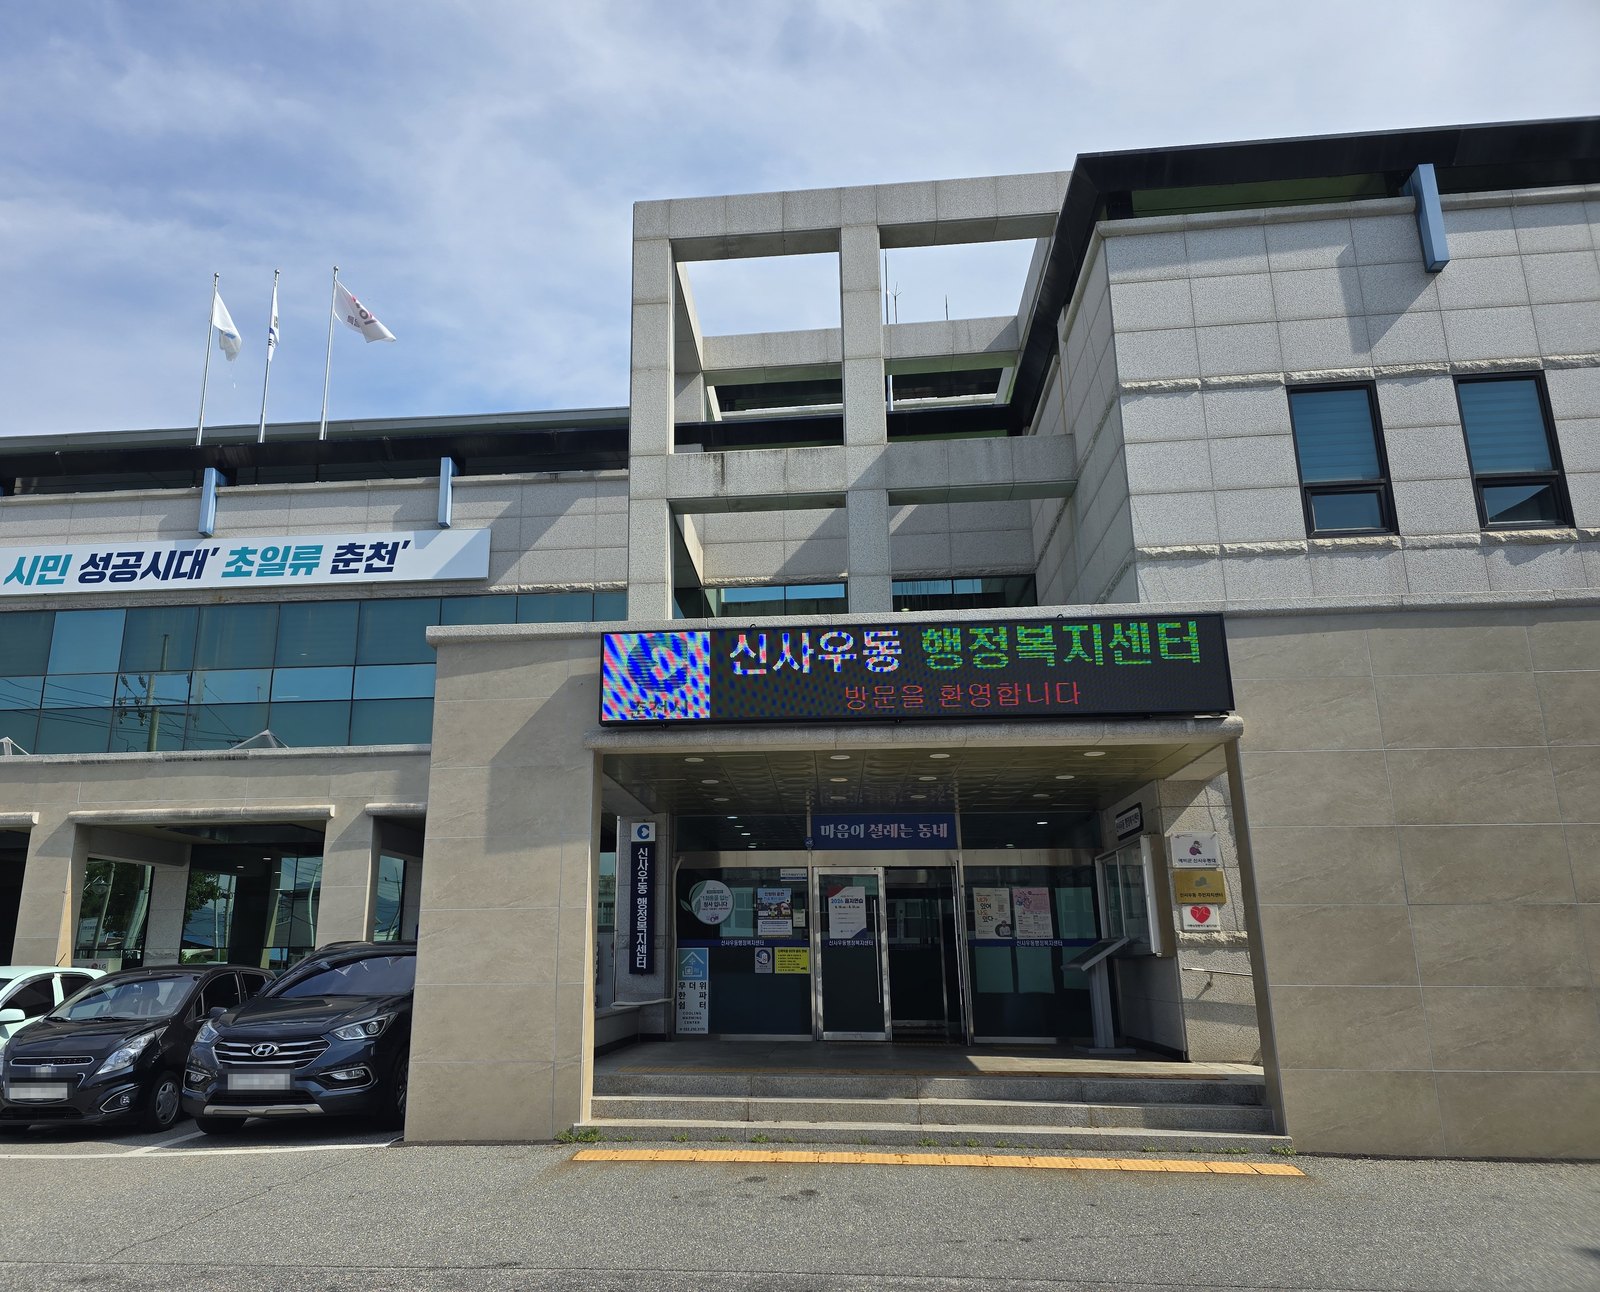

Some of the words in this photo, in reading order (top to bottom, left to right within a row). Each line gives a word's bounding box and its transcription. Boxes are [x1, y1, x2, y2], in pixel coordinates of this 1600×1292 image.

[3, 554, 73, 586] 시민
[221, 544, 324, 578] 초일류
[730, 630, 902, 675] 신사우동
[921, 620, 1201, 671] 행정복지센터
[846, 683, 924, 710] 방문을
[940, 681, 1082, 708] 환영합니다
[820, 823, 865, 839] 마음이
[867, 823, 914, 839] 설레는
[917, 823, 948, 838] 동네
[637, 848, 648, 894] 신사우동
[636, 897, 648, 969] 행정복지센터
